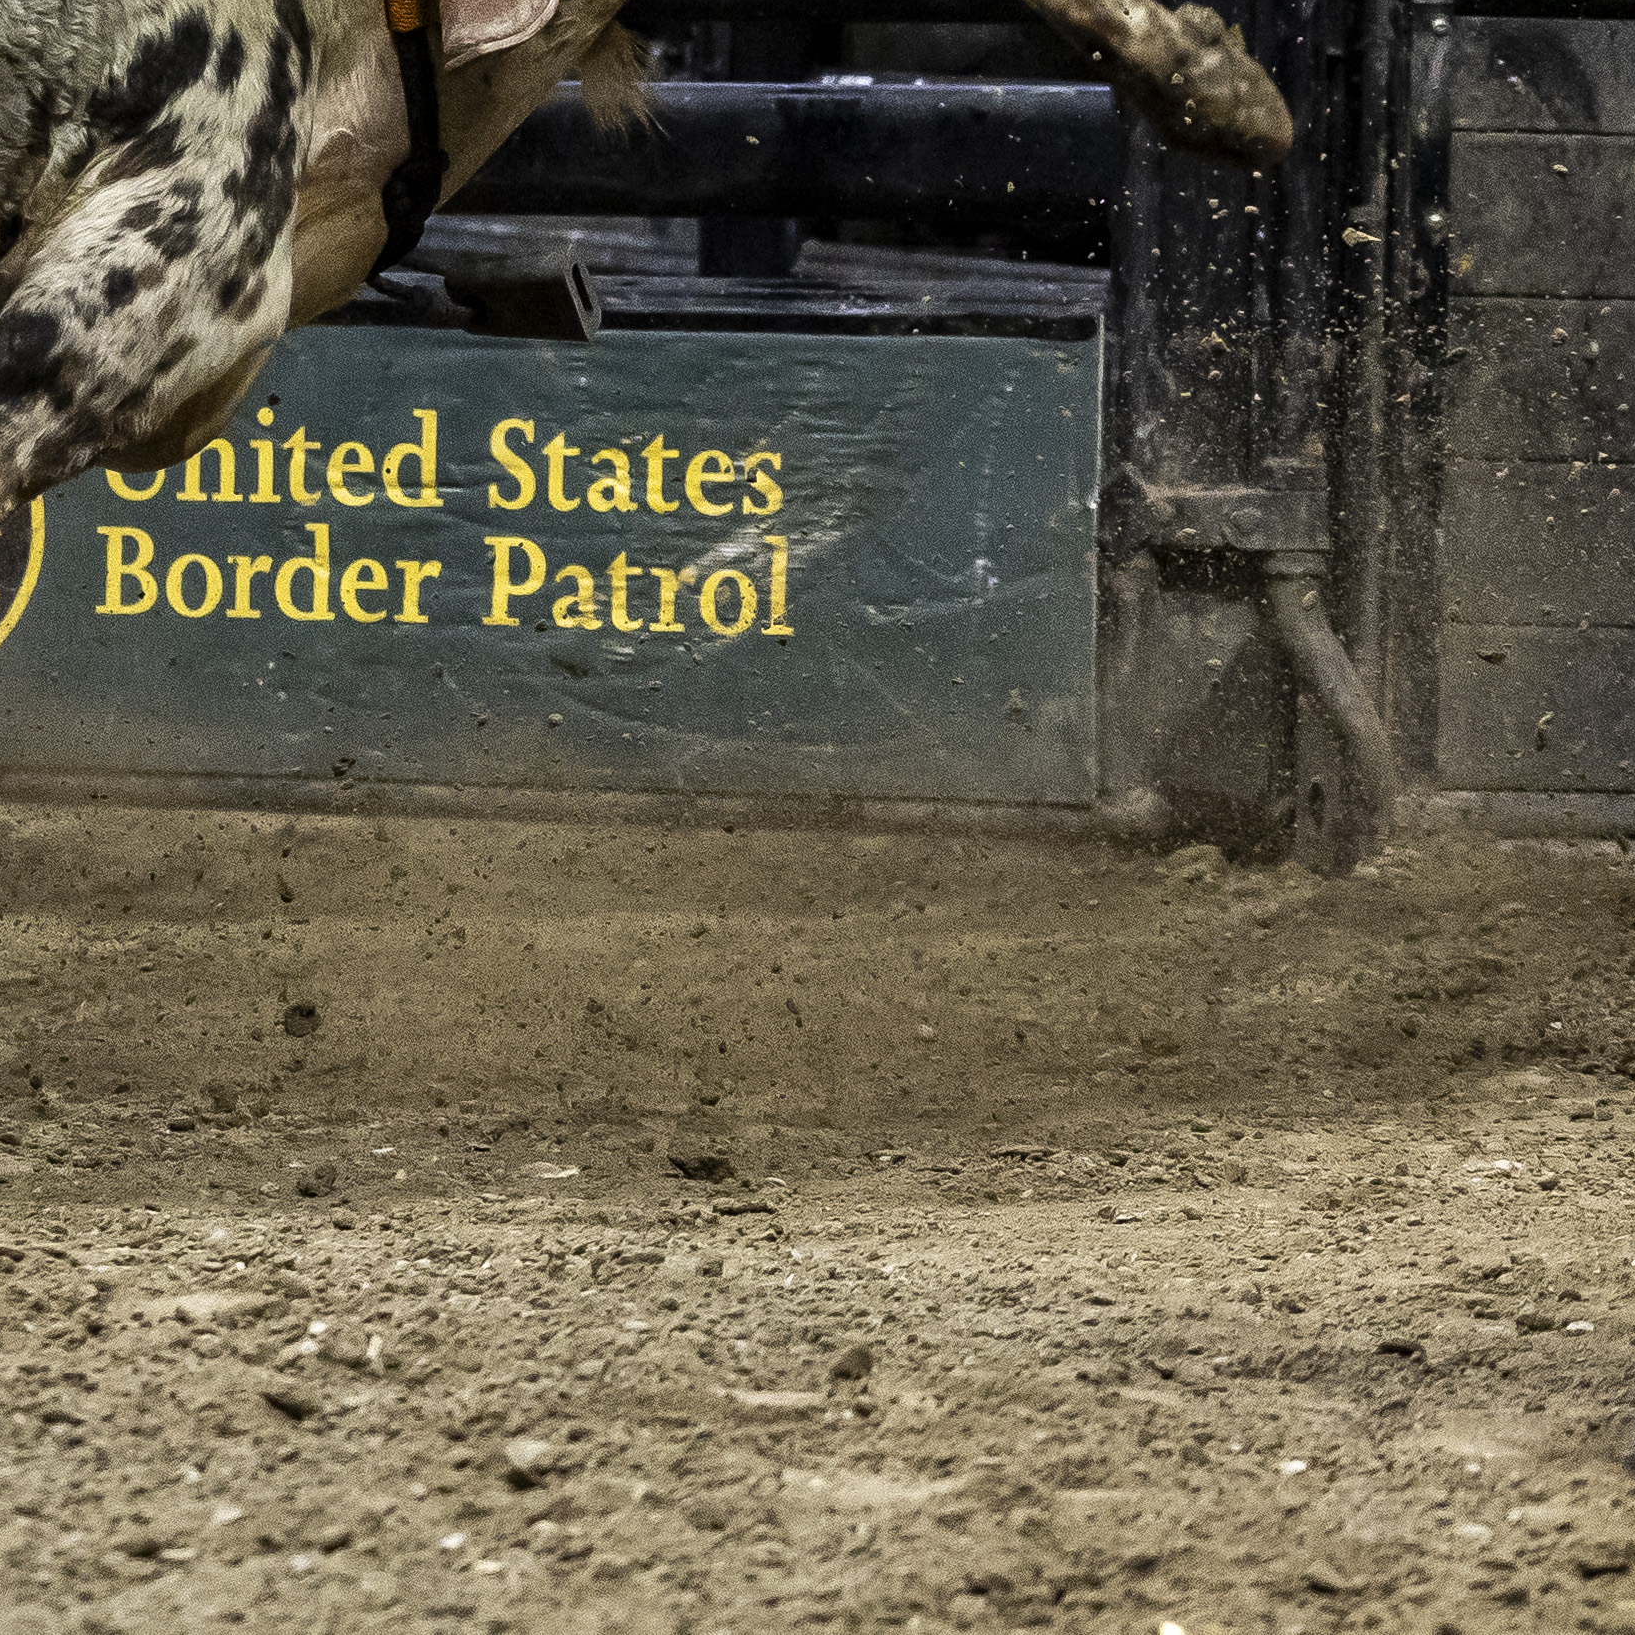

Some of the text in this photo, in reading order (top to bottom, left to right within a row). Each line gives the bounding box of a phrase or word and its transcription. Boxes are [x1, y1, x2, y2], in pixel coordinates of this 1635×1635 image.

[487, 418, 784, 517] States
[95, 523, 795, 636] Border Patrol
